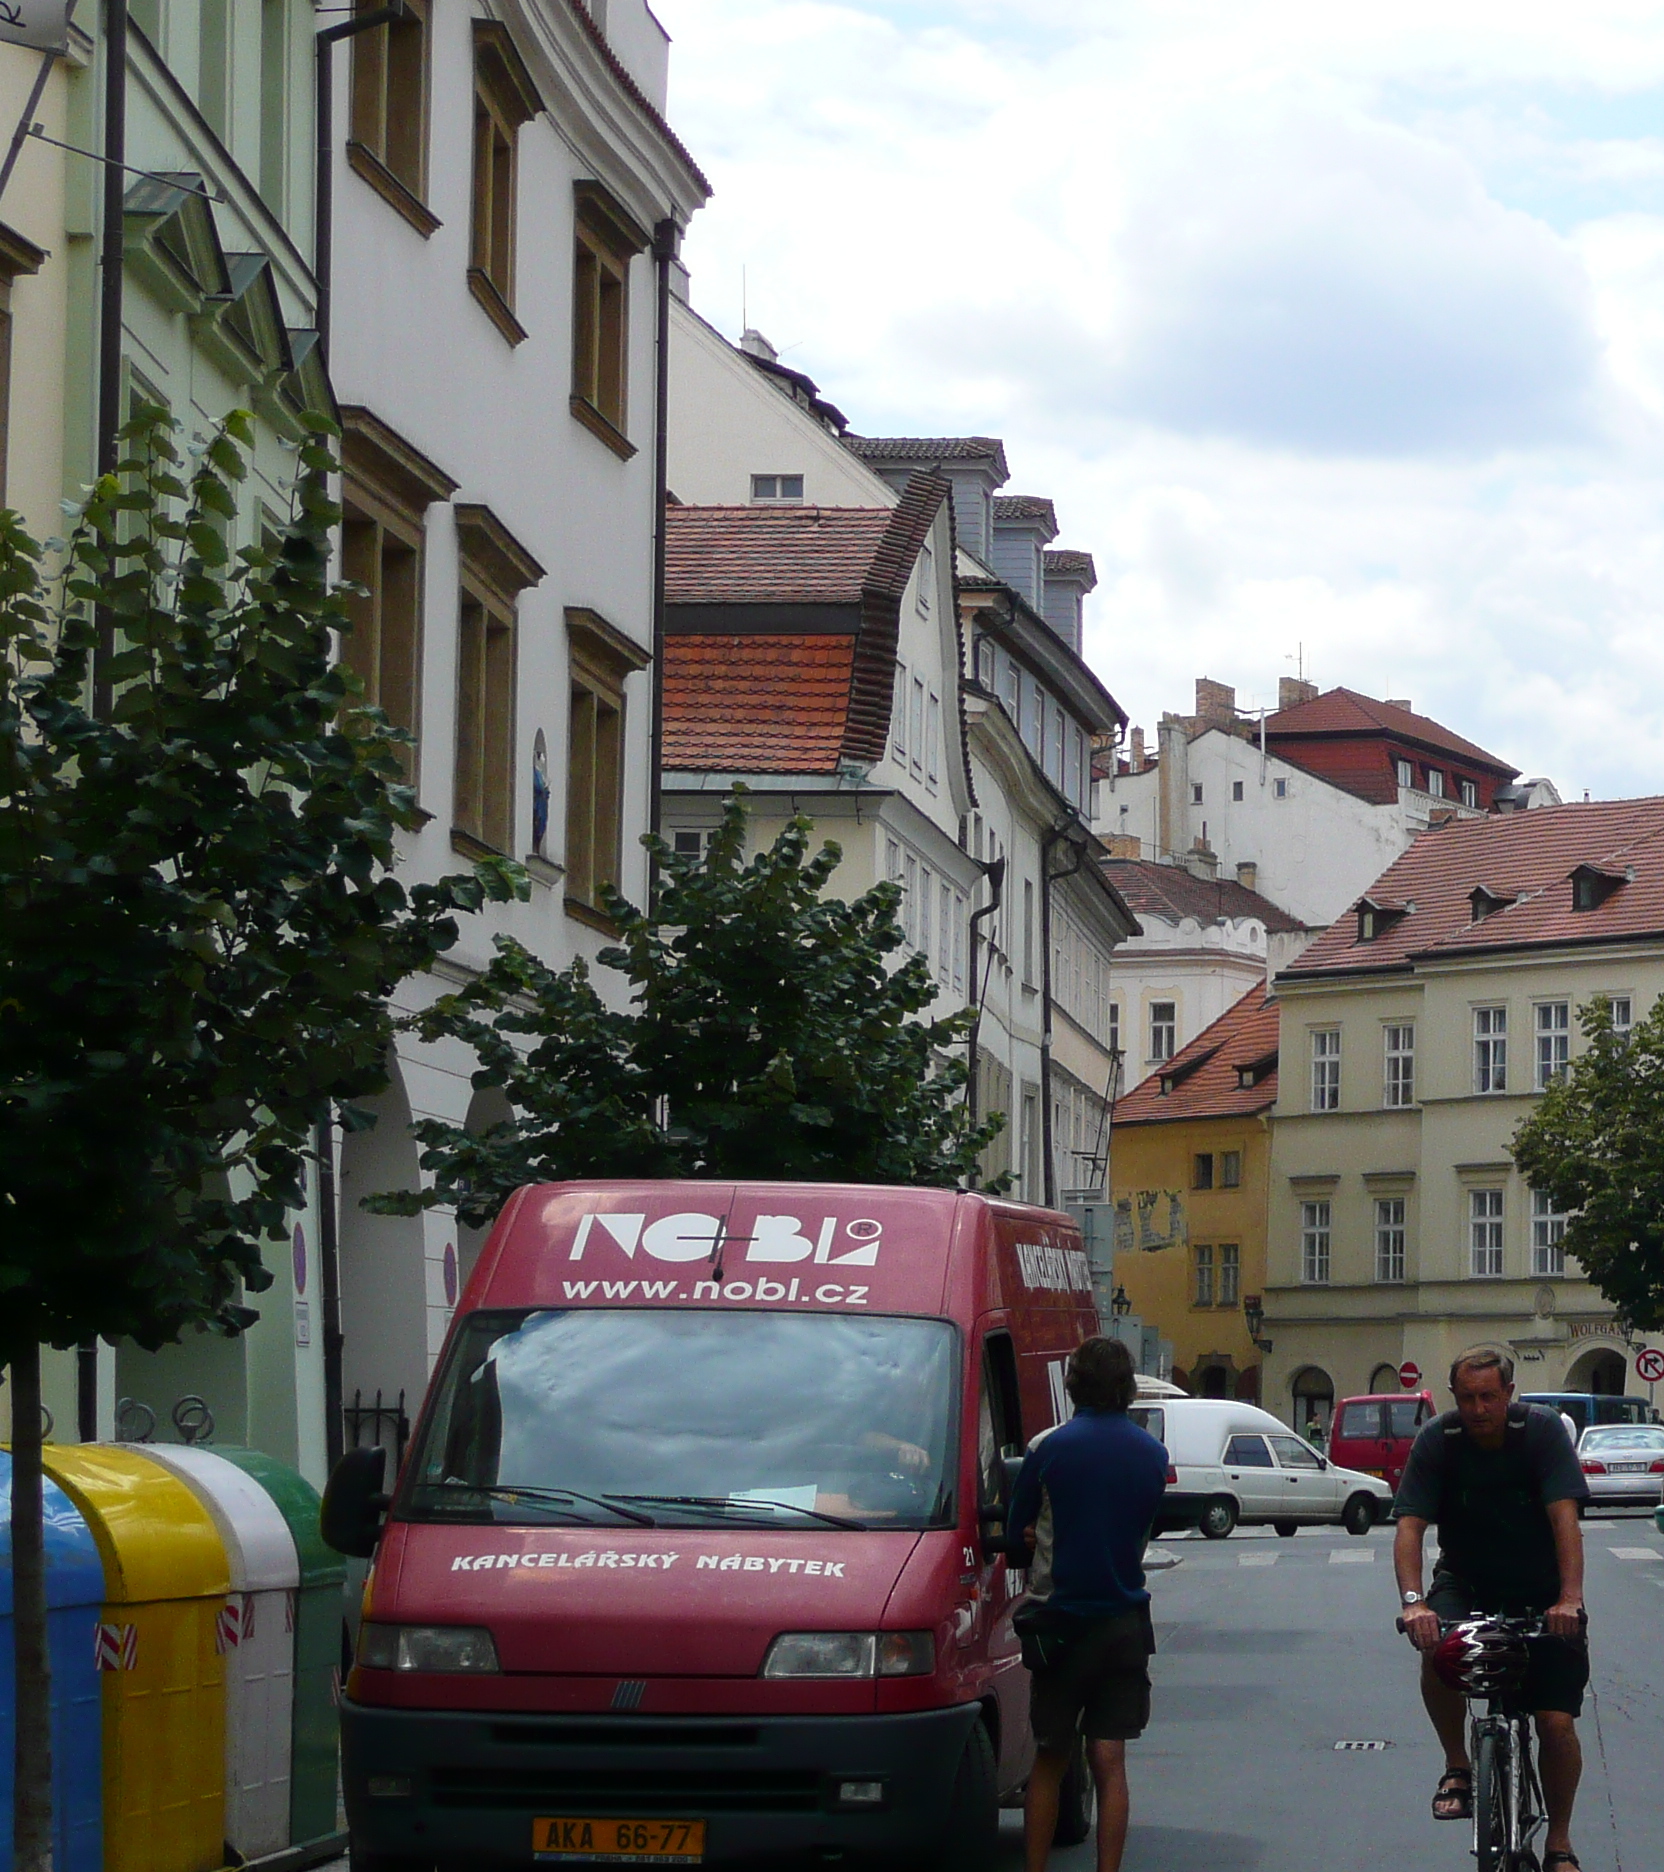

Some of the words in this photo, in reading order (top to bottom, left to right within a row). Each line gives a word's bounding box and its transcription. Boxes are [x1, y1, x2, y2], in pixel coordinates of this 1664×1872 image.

[562, 1277, 870, 1305] www.nobl.cz
[451, 1551, 680, 1572] KANCELÁŘSKÝ
[696, 1553, 847, 1578] NÁBYTEK
[546, 1821, 594, 1849] AKA
[616, 1824, 692, 1851] 66-77
